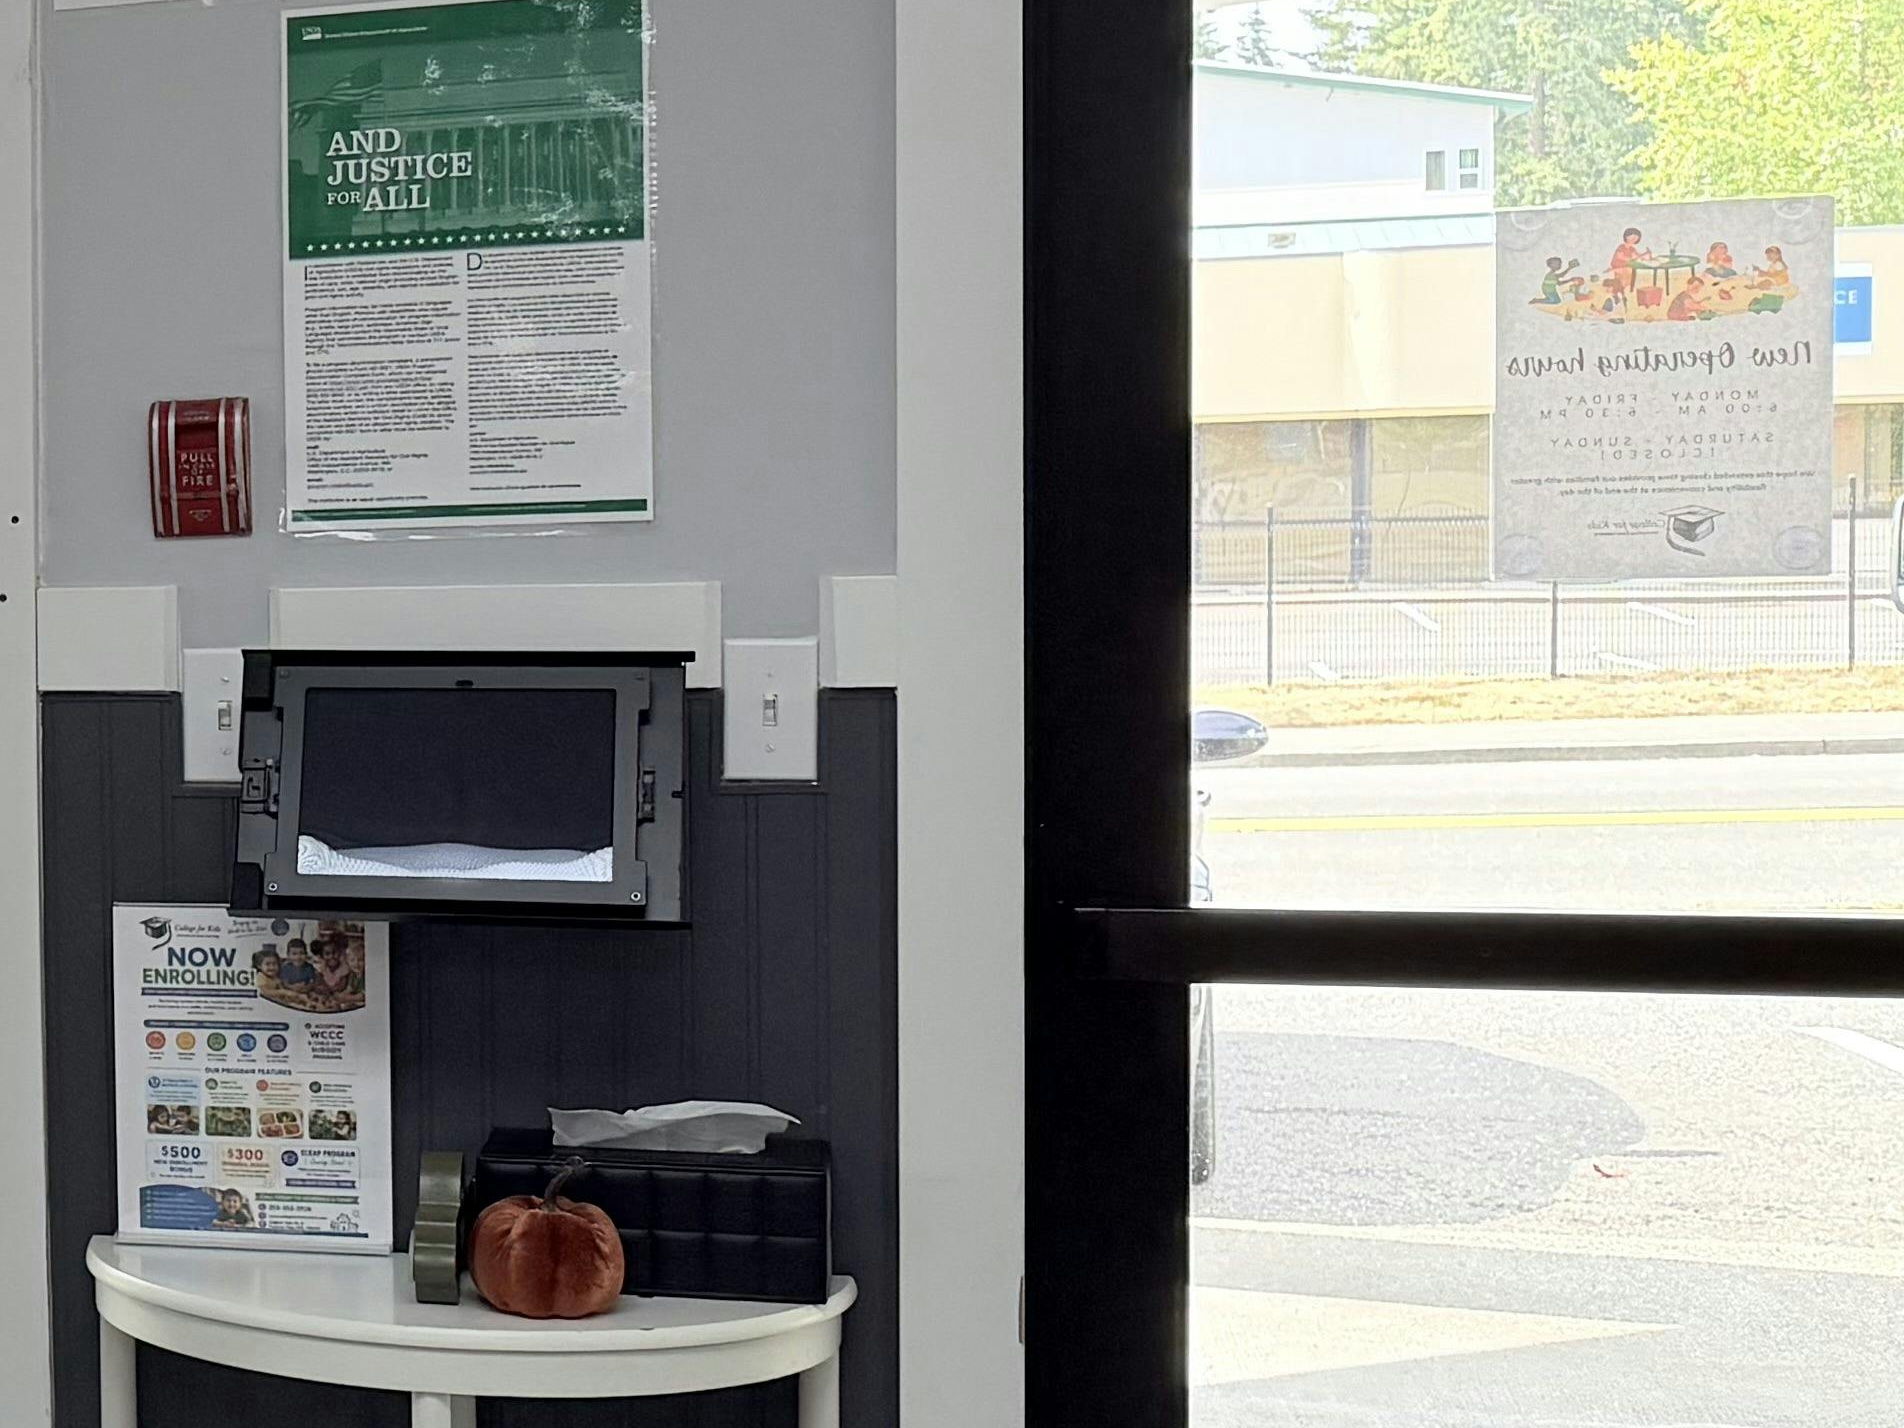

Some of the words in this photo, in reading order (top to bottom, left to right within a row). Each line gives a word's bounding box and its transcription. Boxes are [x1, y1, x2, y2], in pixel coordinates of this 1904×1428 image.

[326, 127, 402, 157] AND
[327, 151, 473, 186] JUSTICE
[327, 191, 361, 205] FOR
[363, 184, 431, 212] ALL
[181, 452, 214, 463] PULL
[182, 475, 214, 486] FIRE
[167, 946, 237, 967] NOW
[143, 968, 256, 987] ENROLLING!
[309, 1030, 344, 1039] WCCC
[161, 1145, 201, 1159] $500
[227, 1148, 264, 1161] $300
